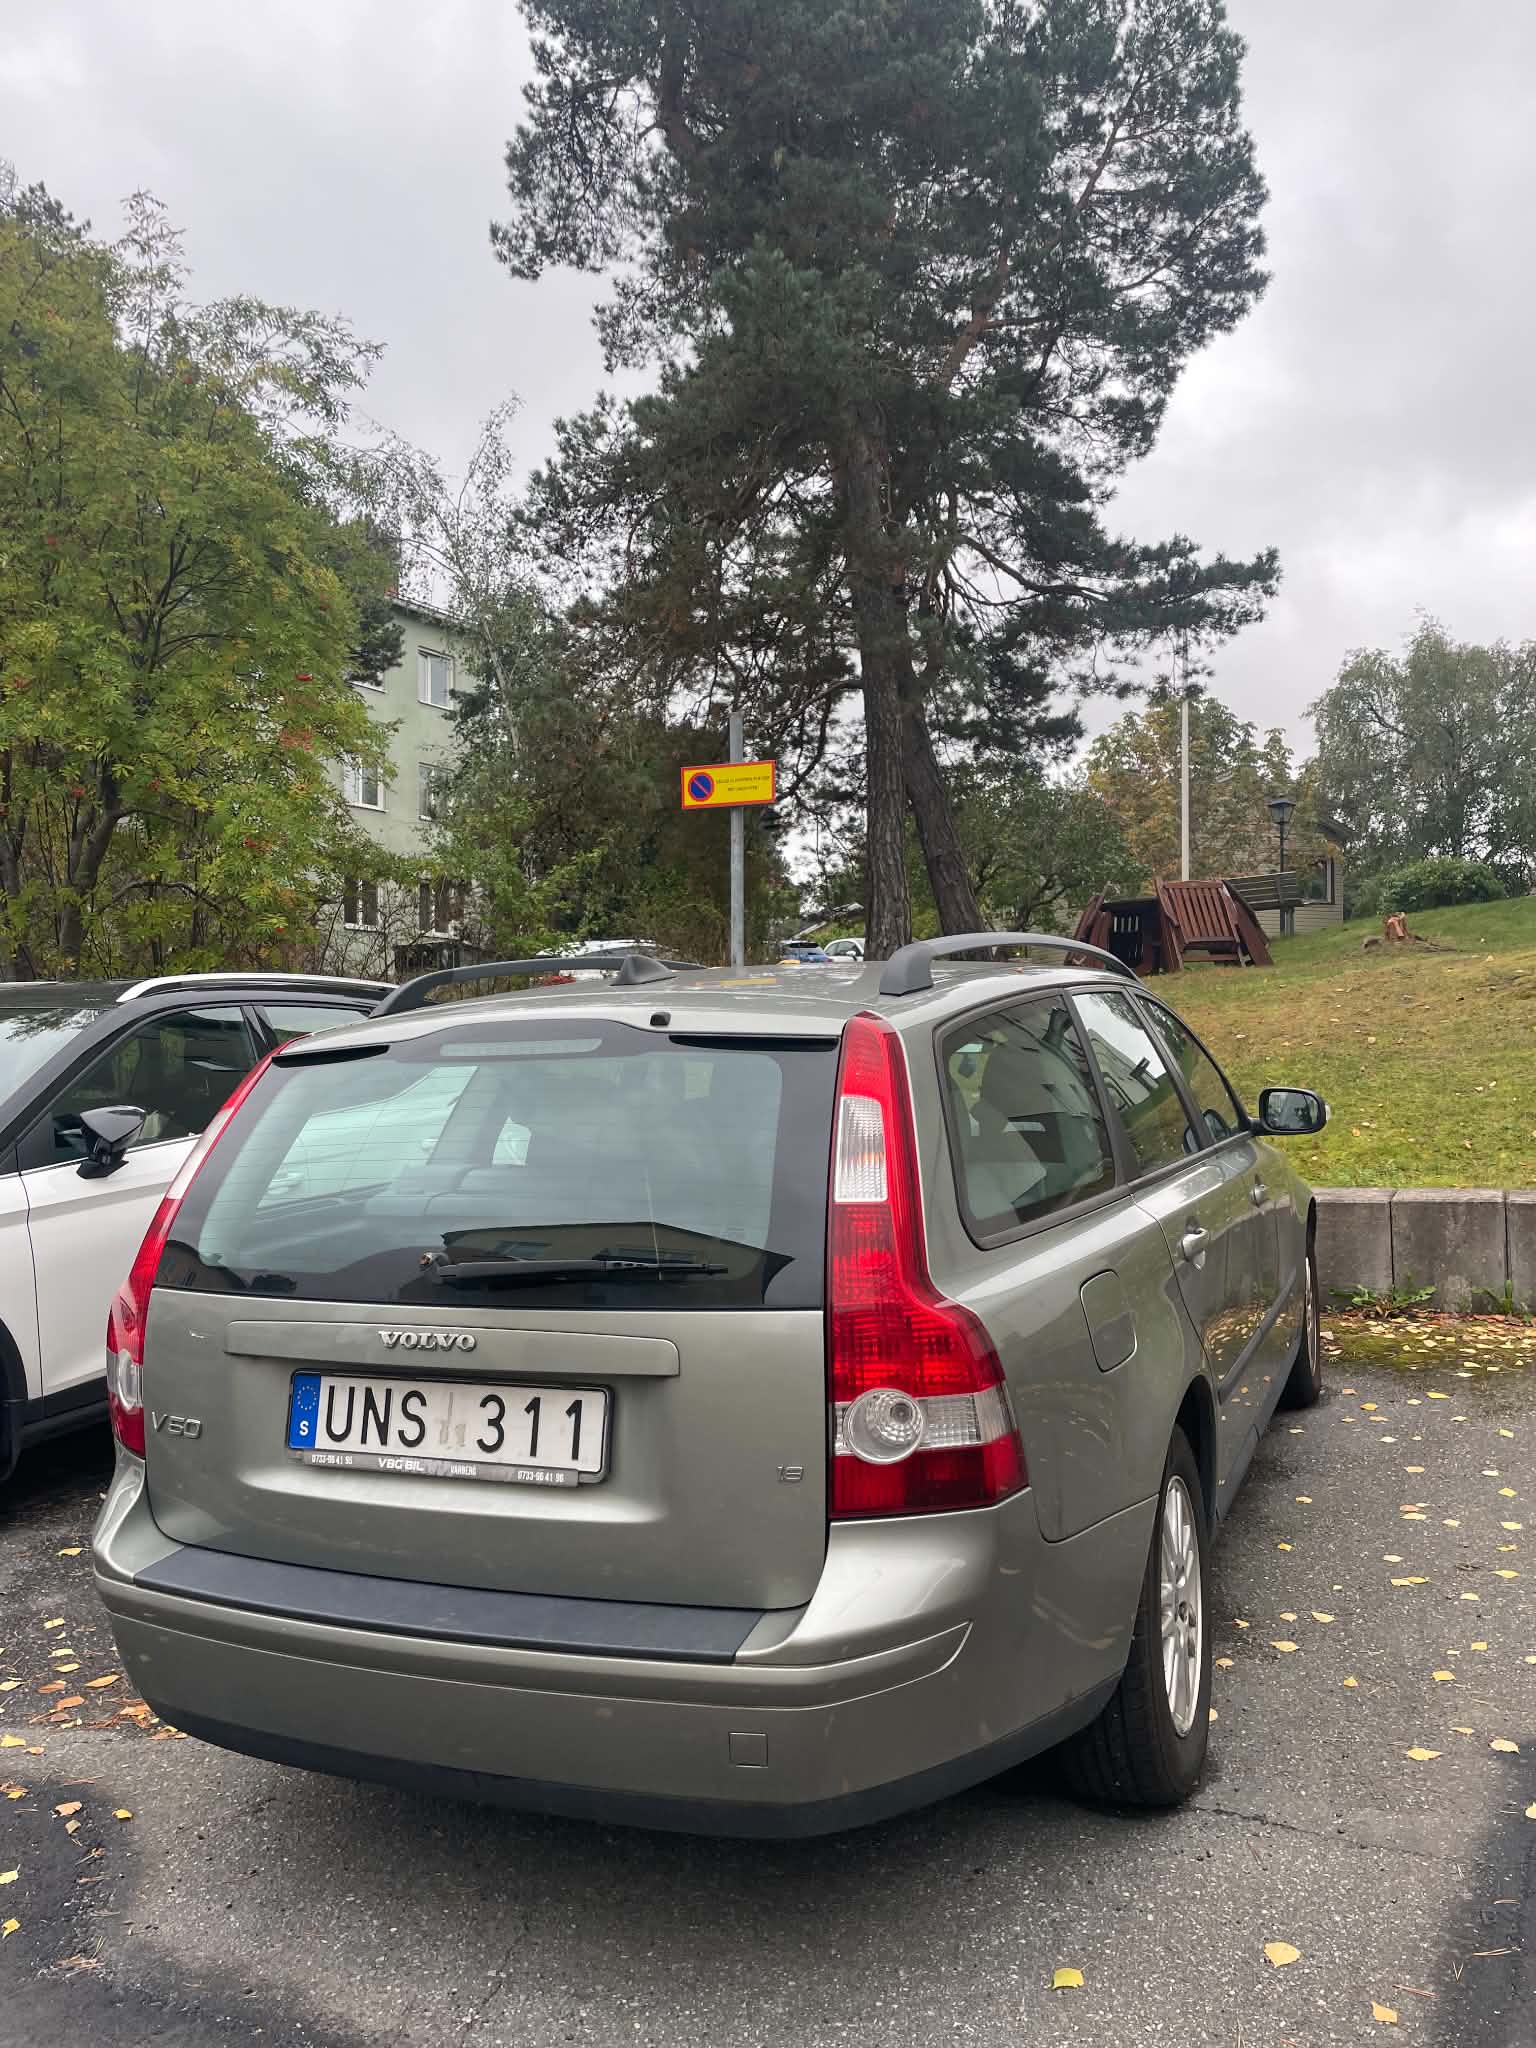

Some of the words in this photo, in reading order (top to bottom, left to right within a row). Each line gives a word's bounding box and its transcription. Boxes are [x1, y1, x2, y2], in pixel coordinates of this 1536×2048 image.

[378, 1331, 476, 1352] VOLVO
[299, 1420, 309, 1436] S
[326, 1385, 427, 1448] UNS
[476, 1394, 582, 1459] 311
[378, 1457, 403, 1470] VBG
[404, 1459, 425, 1472] BIL
